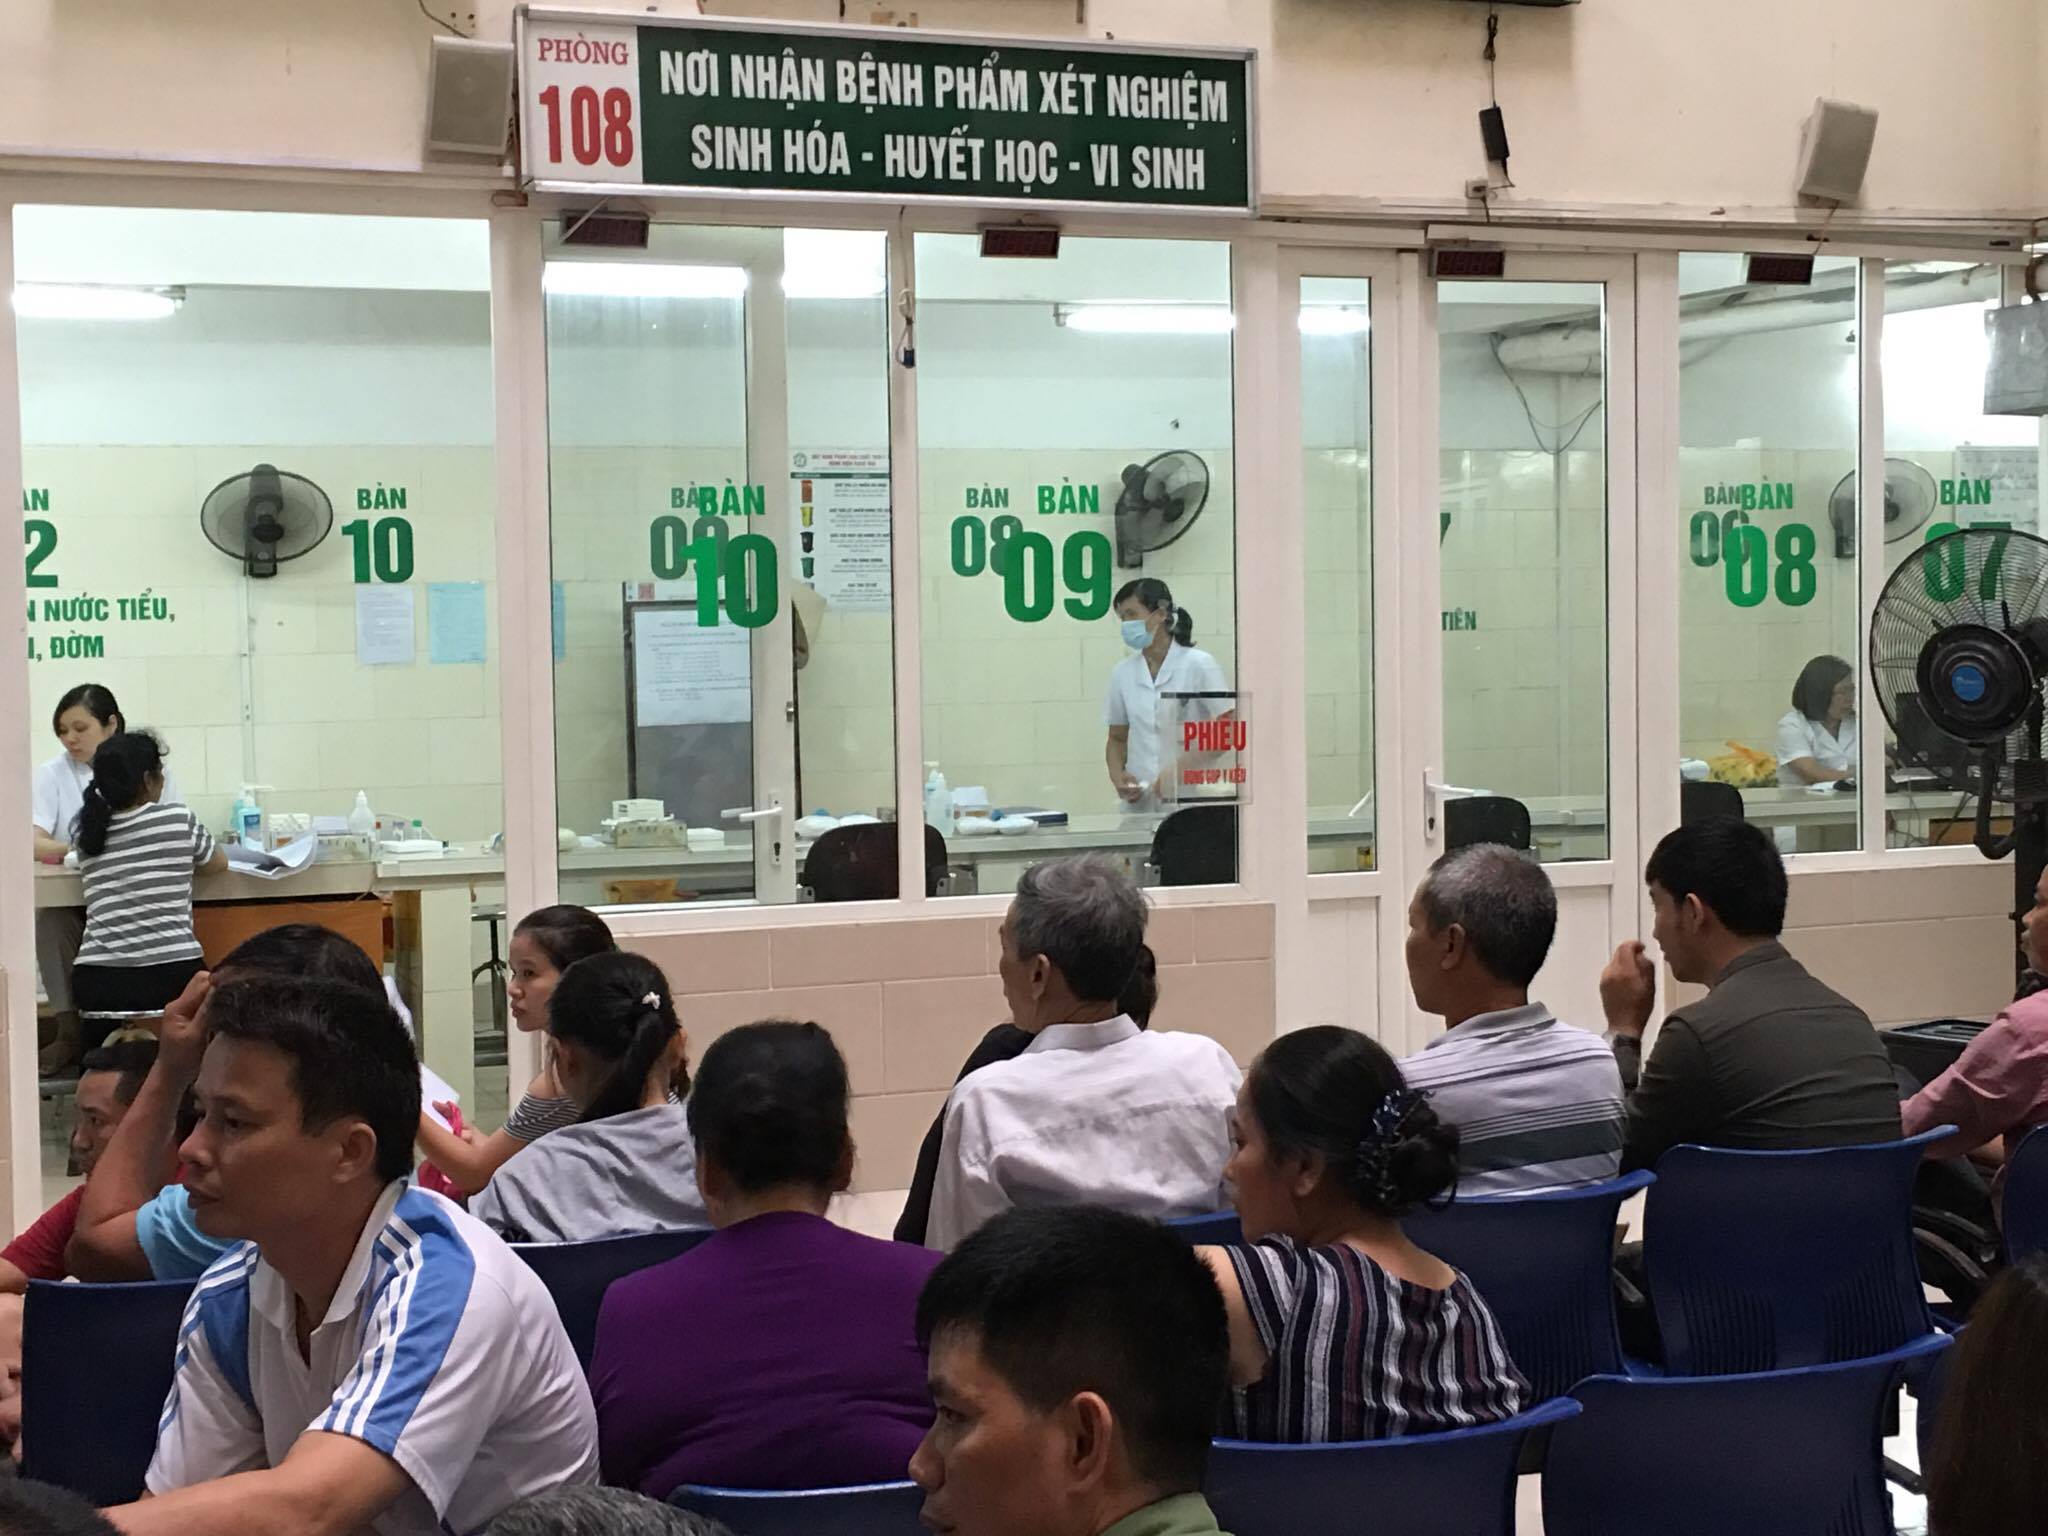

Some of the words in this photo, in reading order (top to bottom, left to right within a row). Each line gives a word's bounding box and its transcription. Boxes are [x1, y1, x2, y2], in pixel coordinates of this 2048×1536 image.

[538, 33, 629, 65] PHÒNG
[659, 48, 719, 98] NƠI
[730, 47, 826, 111] NHẬN
[836, 51, 925, 114] BỆNH
[934, 50, 1029, 113] PHẨM
[1038, 63, 1097, 116] XÉT
[1106, 69, 1229, 130] NGHIỆM
[538, 85, 634, 167] 108
[690, 124, 773, 173] SINH
[783, 119, 852, 176] HÓA
[861, 152, 874, 161] -
[884, 124, 985, 182] HUYẾT
[994, 138, 1059, 193] HỌC
[1068, 161, 1081, 171] -
[1090, 143, 1120, 188] VI
[1131, 146, 1206, 191] SINH
[357, 482, 407, 510] BÀN
[671, 481, 700, 509] BÀ
[698, 478, 766, 518] BÀN
[966, 482, 1009, 508] BÀN
[1037, 476, 1100, 515] BÀN
[1704, 482, 1742, 505] BÀN
[1740, 475, 1793, 511] BÀN
[1940, 472, 1992, 505] BÀN
[342, 516, 414, 583] 10
[950, 514, 1024, 577] 08
[1924, 522, 2012, 603] 07
[680, 533, 779, 628] 10
[1004, 530, 1113, 622] 09
[1724, 523, 1817, 608] 08
[44, 592, 109, 622] NƯỚC
[116, 588, 175, 623] TIỂU,
[50, 629, 105, 660] ĐỜM
